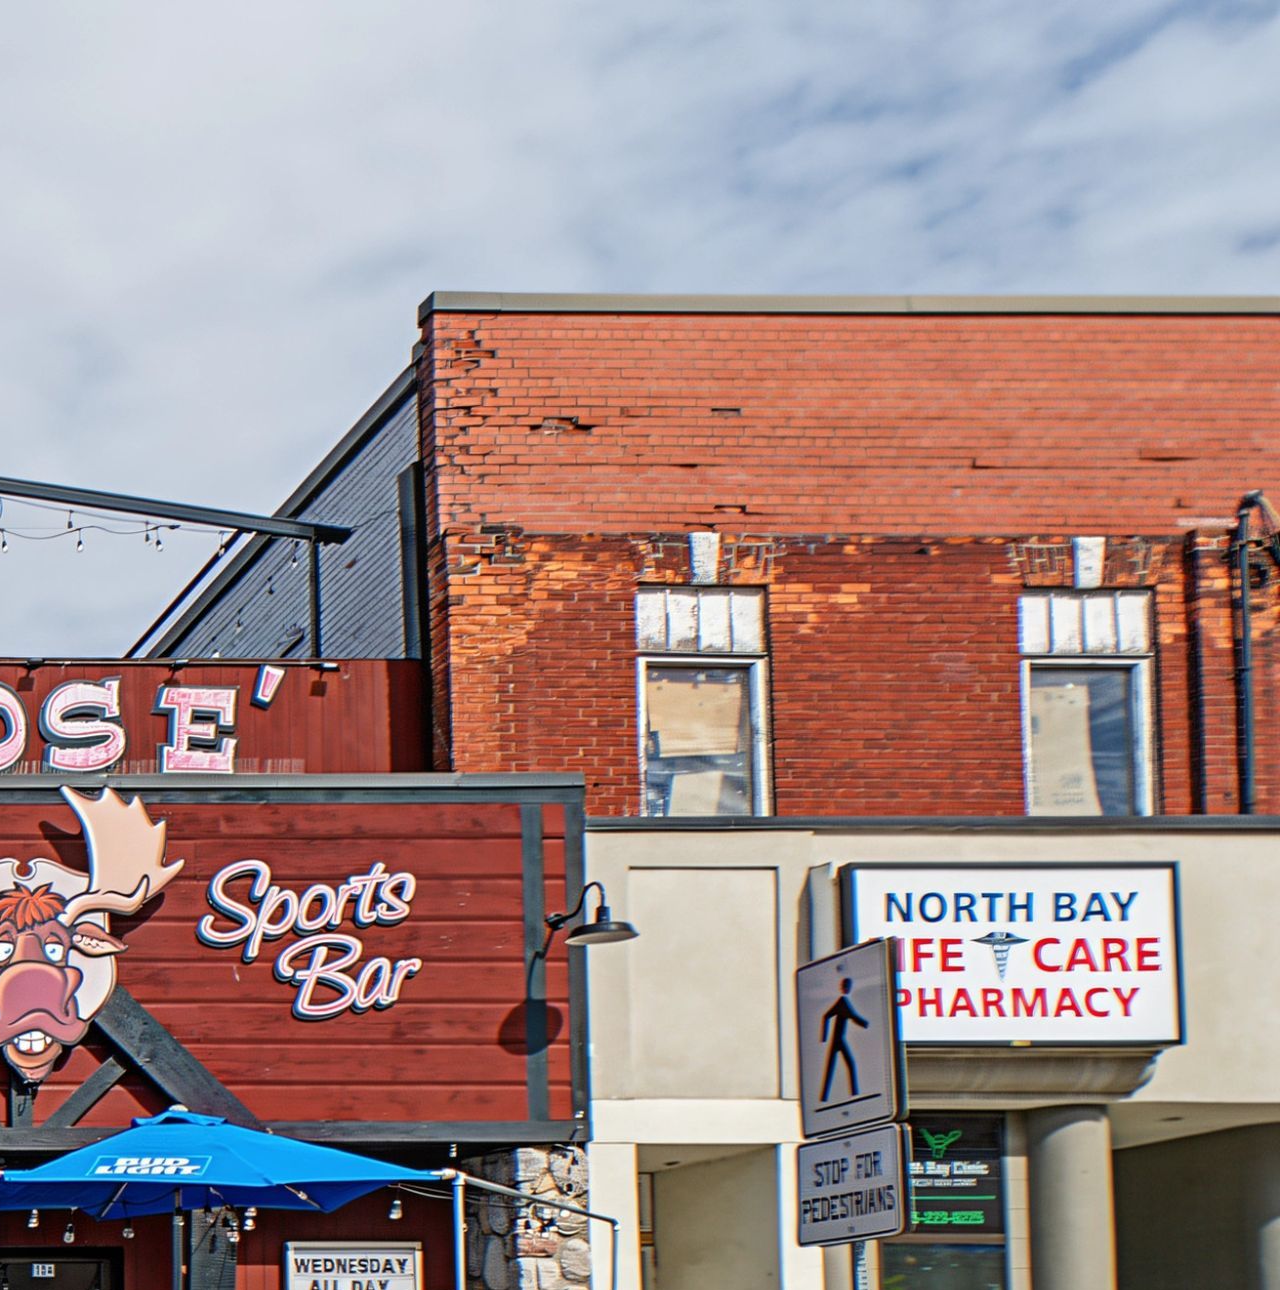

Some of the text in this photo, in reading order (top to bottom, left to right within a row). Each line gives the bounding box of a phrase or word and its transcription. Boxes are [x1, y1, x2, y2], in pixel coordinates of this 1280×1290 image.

[195, 859, 417, 963] Sports
[884, 891, 1139, 923] NORTH BAY
[896, 937, 1163, 973] IFE CARE
[272, 934, 423, 1023] Bar
[896, 987, 1140, 1018] PHARMACY
[814, 1157, 849, 1187] STOP
[855, 1151, 883, 1180] FOR
[801, 1184, 896, 1225] PEDESTRIANS
[294, 1258, 409, 1274] WEDNESDAY
